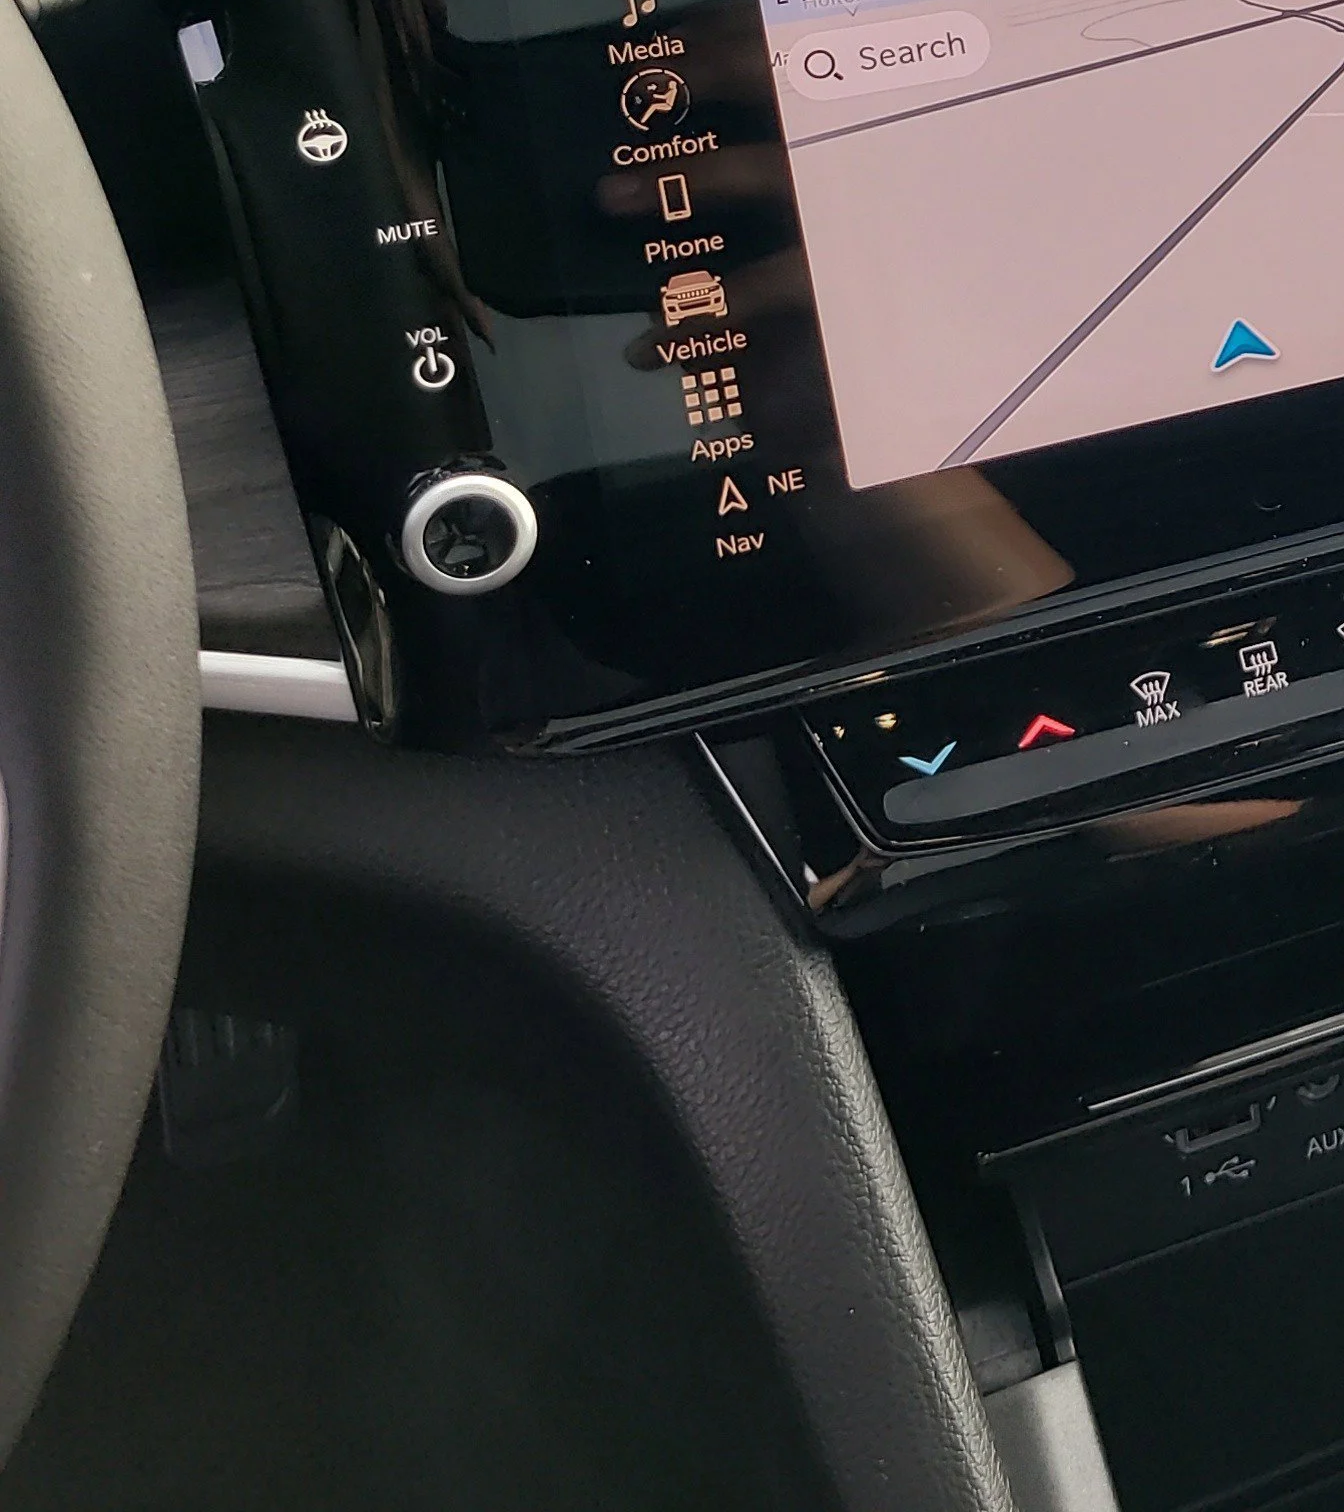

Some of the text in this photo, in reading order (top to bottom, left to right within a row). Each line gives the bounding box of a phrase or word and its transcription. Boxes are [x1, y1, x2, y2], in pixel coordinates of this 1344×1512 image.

[608, 35, 685, 64] Media
[859, 32, 966, 71] Search
[612, 131, 719, 166] Comfort
[376, 219, 438, 245] MUTE
[644, 232, 725, 264] Phone
[406, 327, 449, 348] VOL
[656, 329, 747, 364] Vehicle
[690, 432, 754, 463] Apps
[767, 469, 805, 496] NE
[715, 532, 764, 558] Nav
[1242, 671, 1289, 699] REAR
[1135, 700, 1181, 728] MAX
[1180, 1175, 1194, 1196] 1
